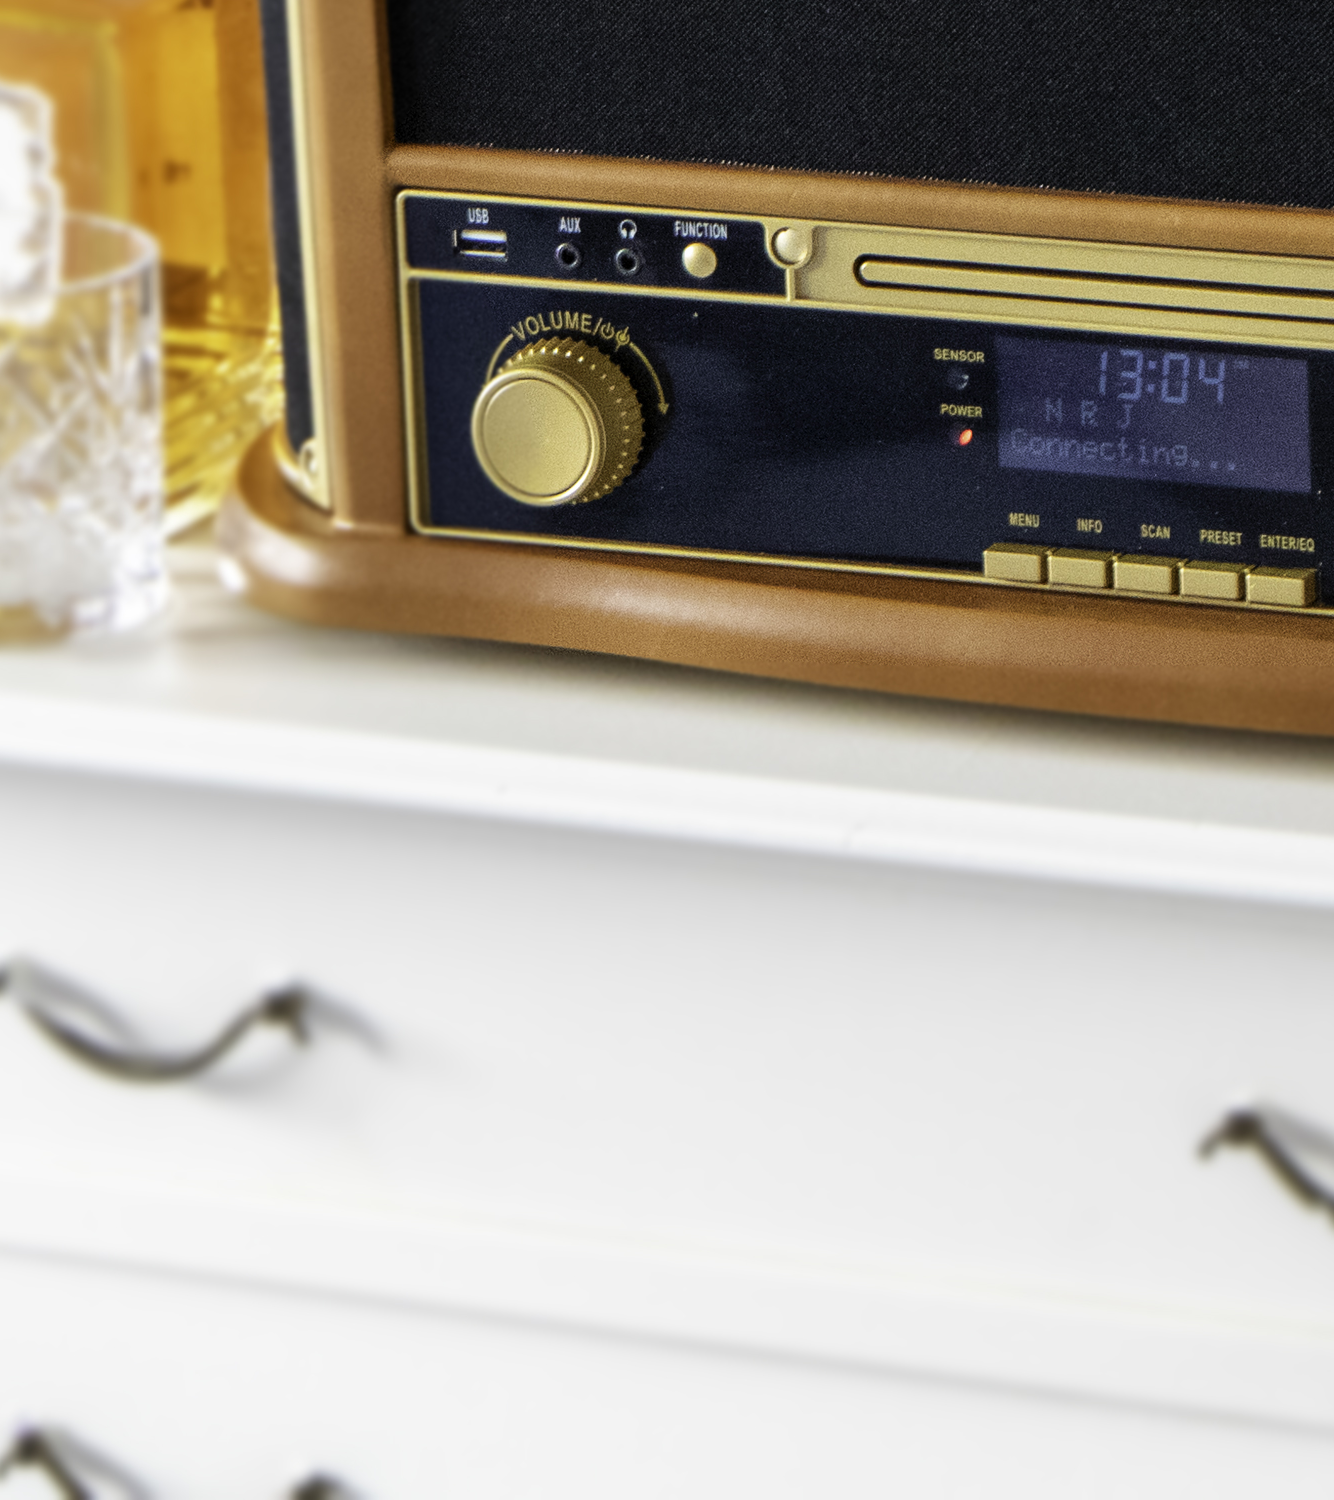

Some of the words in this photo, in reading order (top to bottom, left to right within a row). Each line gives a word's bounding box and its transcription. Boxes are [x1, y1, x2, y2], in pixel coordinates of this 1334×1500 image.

[467, 207, 490, 225] USB
[559, 216, 582, 235] AUX
[674, 220, 729, 240] FUNCTION
[933, 347, 985, 363] SENSOR
[1098, 349, 1227, 405] 13:04
[940, 403, 983, 419] POWER
[1009, 512, 1040, 528] MENU
[1076, 518, 1103, 534] INFO
[1140, 524, 1171, 540] SCAN
[1199, 529, 1243, 547] PRESET
[1259, 534, 1316, 553] ENTER/EQ
